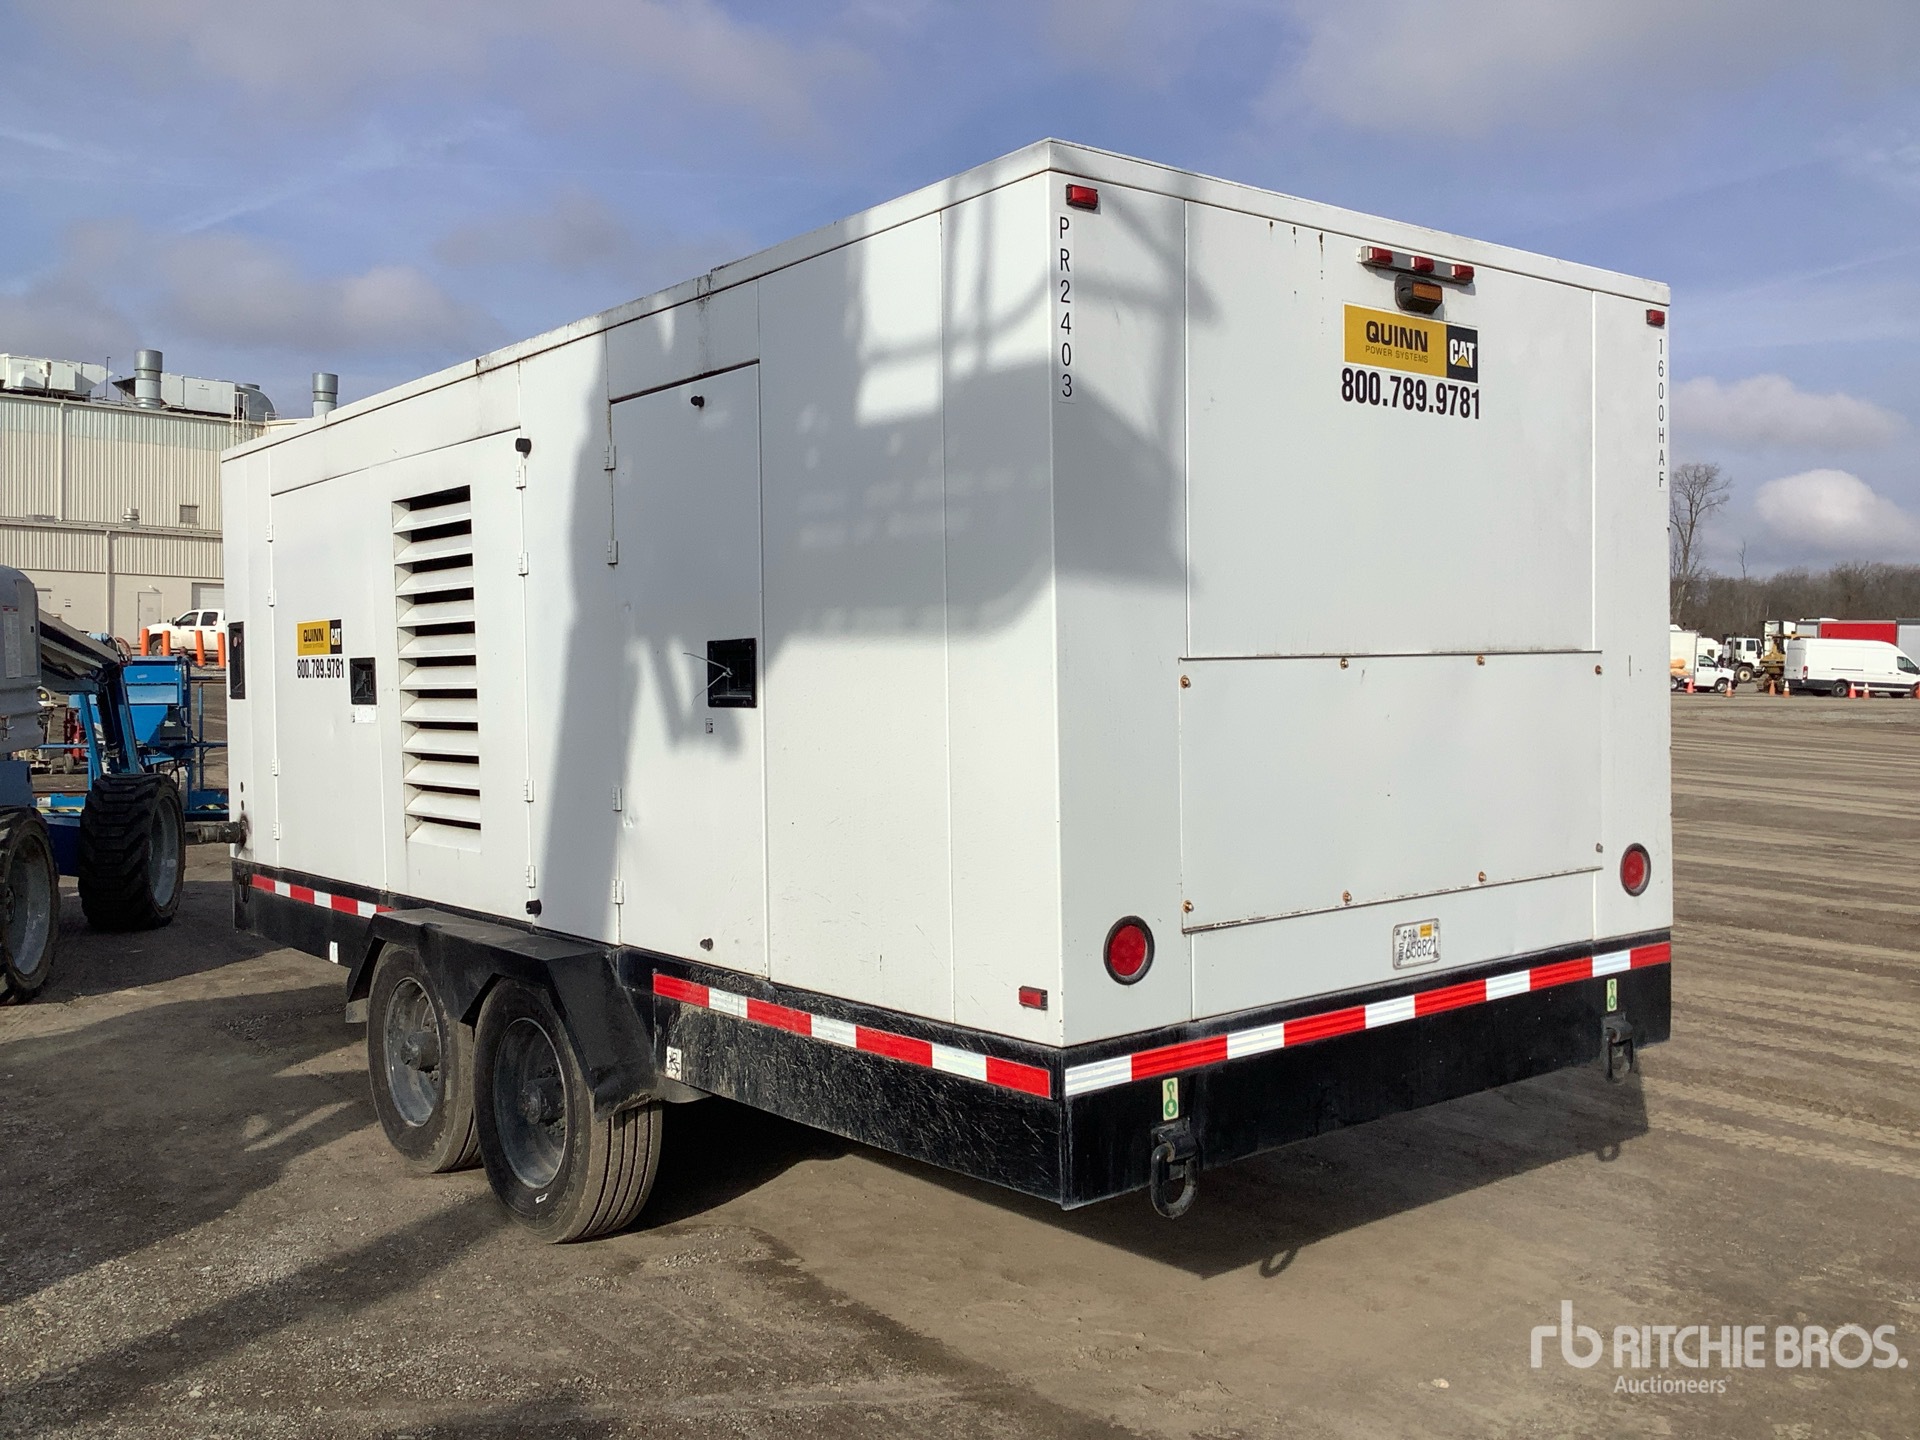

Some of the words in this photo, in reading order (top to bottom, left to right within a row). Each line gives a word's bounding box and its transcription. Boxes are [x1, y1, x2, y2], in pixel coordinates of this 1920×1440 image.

[1058, 216, 1073, 398] PR2403
[1365, 320, 1428, 353] QUINN
[1365, 345, 1393, 358] POWER
[1395, 350, 1429, 364] SYSTEMS
[1450, 338, 1475, 369] CAT
[1341, 367, 1480, 420] 800.789.9781
[1657, 338, 1665, 488] 1600HAF
[303, 628, 324, 642] QUINN
[330, 628, 341, 645] CAT
[296, 658, 344, 678] 800.789.9781
